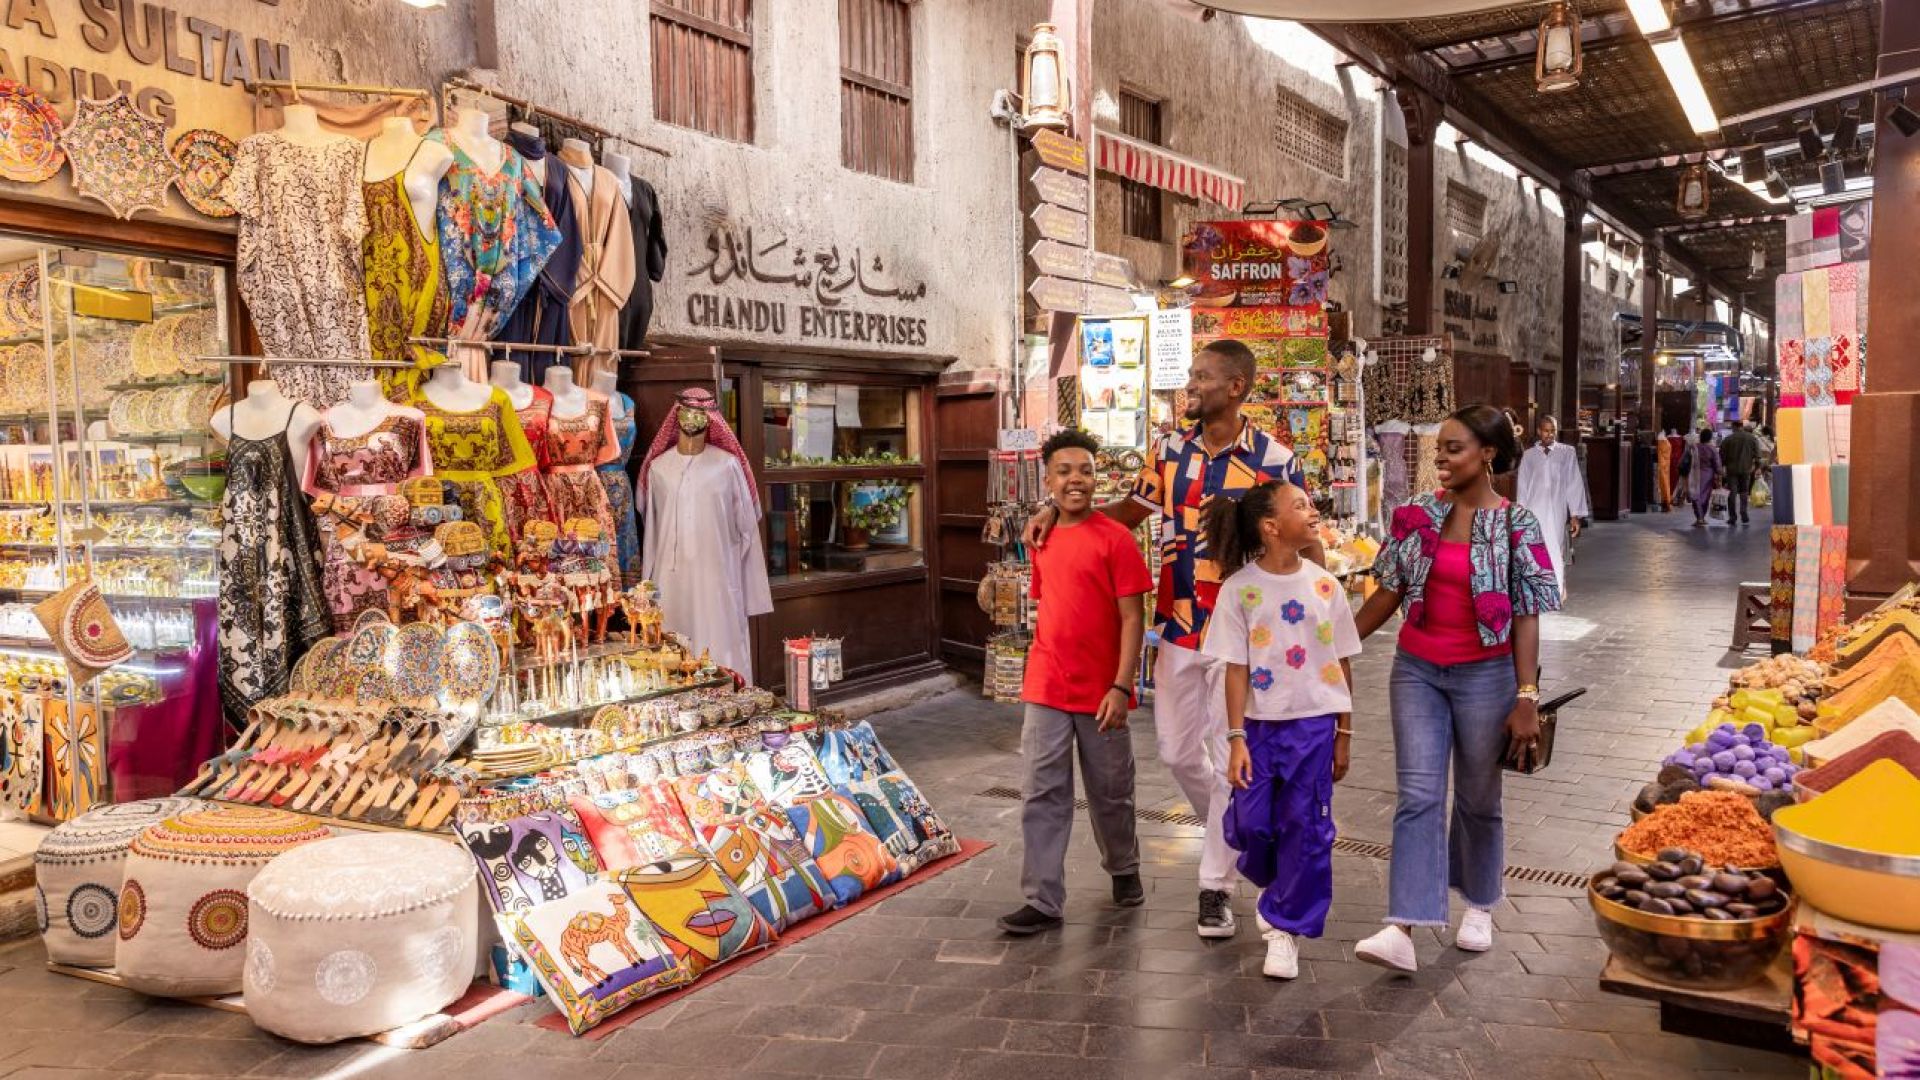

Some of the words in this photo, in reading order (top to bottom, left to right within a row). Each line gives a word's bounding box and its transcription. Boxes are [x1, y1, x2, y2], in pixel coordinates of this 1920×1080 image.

[81, 0, 292, 95] SULTAN
[815, 244, 927, 306] مشاريع
[1210, 262, 1282, 280] SAFFRON
[687, 293, 787, 334] CHANDU
[800, 305, 928, 346] ENTERPRISES
